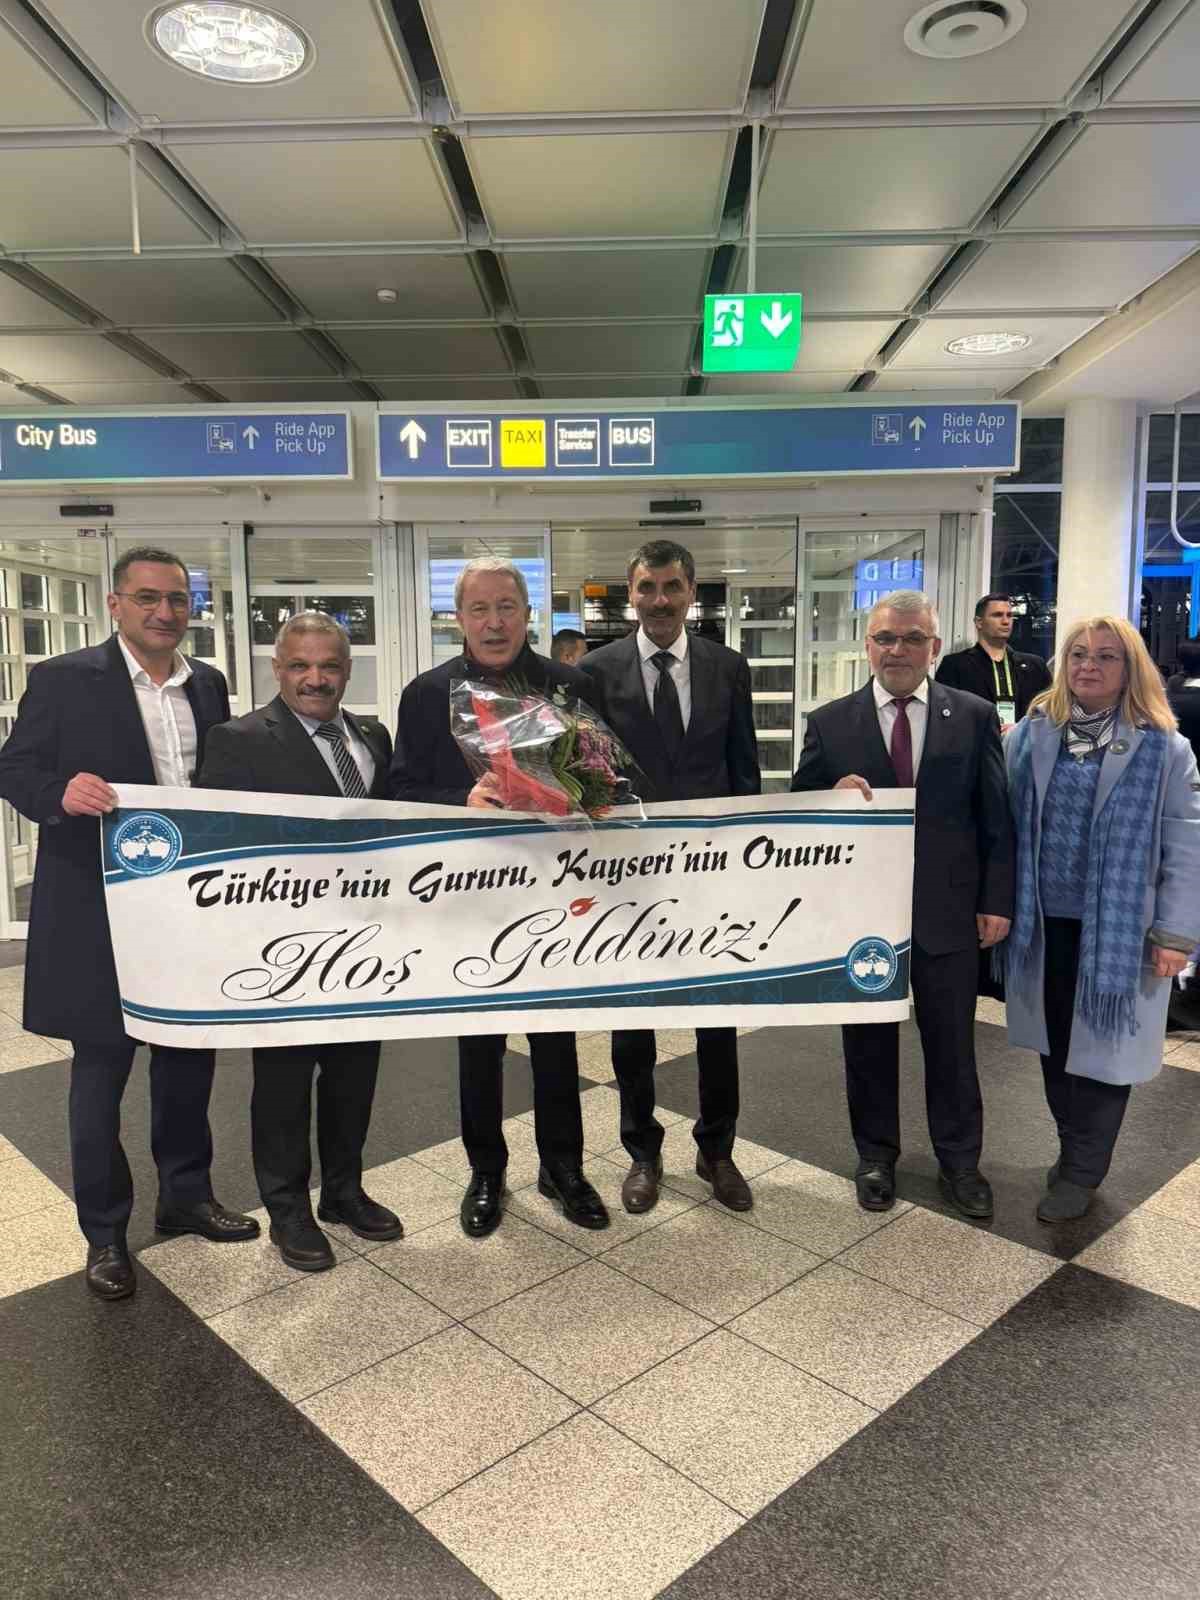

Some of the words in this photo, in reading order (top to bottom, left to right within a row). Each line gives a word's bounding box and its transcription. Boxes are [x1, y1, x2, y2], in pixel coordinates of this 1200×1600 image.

[943, 412, 973, 427] Ride
[977, 412, 1005, 429] App
[16, 424, 55, 451] City
[59, 424, 97, 446] Bus
[275, 422, 305, 436] Ride
[308, 422, 336, 439] App
[448, 428, 489, 447] EXIT
[505, 430, 543, 445] TAXI
[613, 427, 651, 445] BUS
[942, 429, 971, 444] Pick
[975, 428, 995, 447] Up
[275, 438, 303, 453] Pick
[307, 438, 326, 456] Up
[559, 439, 593, 451] Service
[187, 867, 391, 909] Türkiye'nin
[408, 861, 537, 903] Gururu,
[551, 839, 728, 887] Kayseri'nin
[742, 834, 855, 870] Onuru:
[220, 922, 422, 1002] Hoş
[452, 897, 803, 989] Geldiniz!
